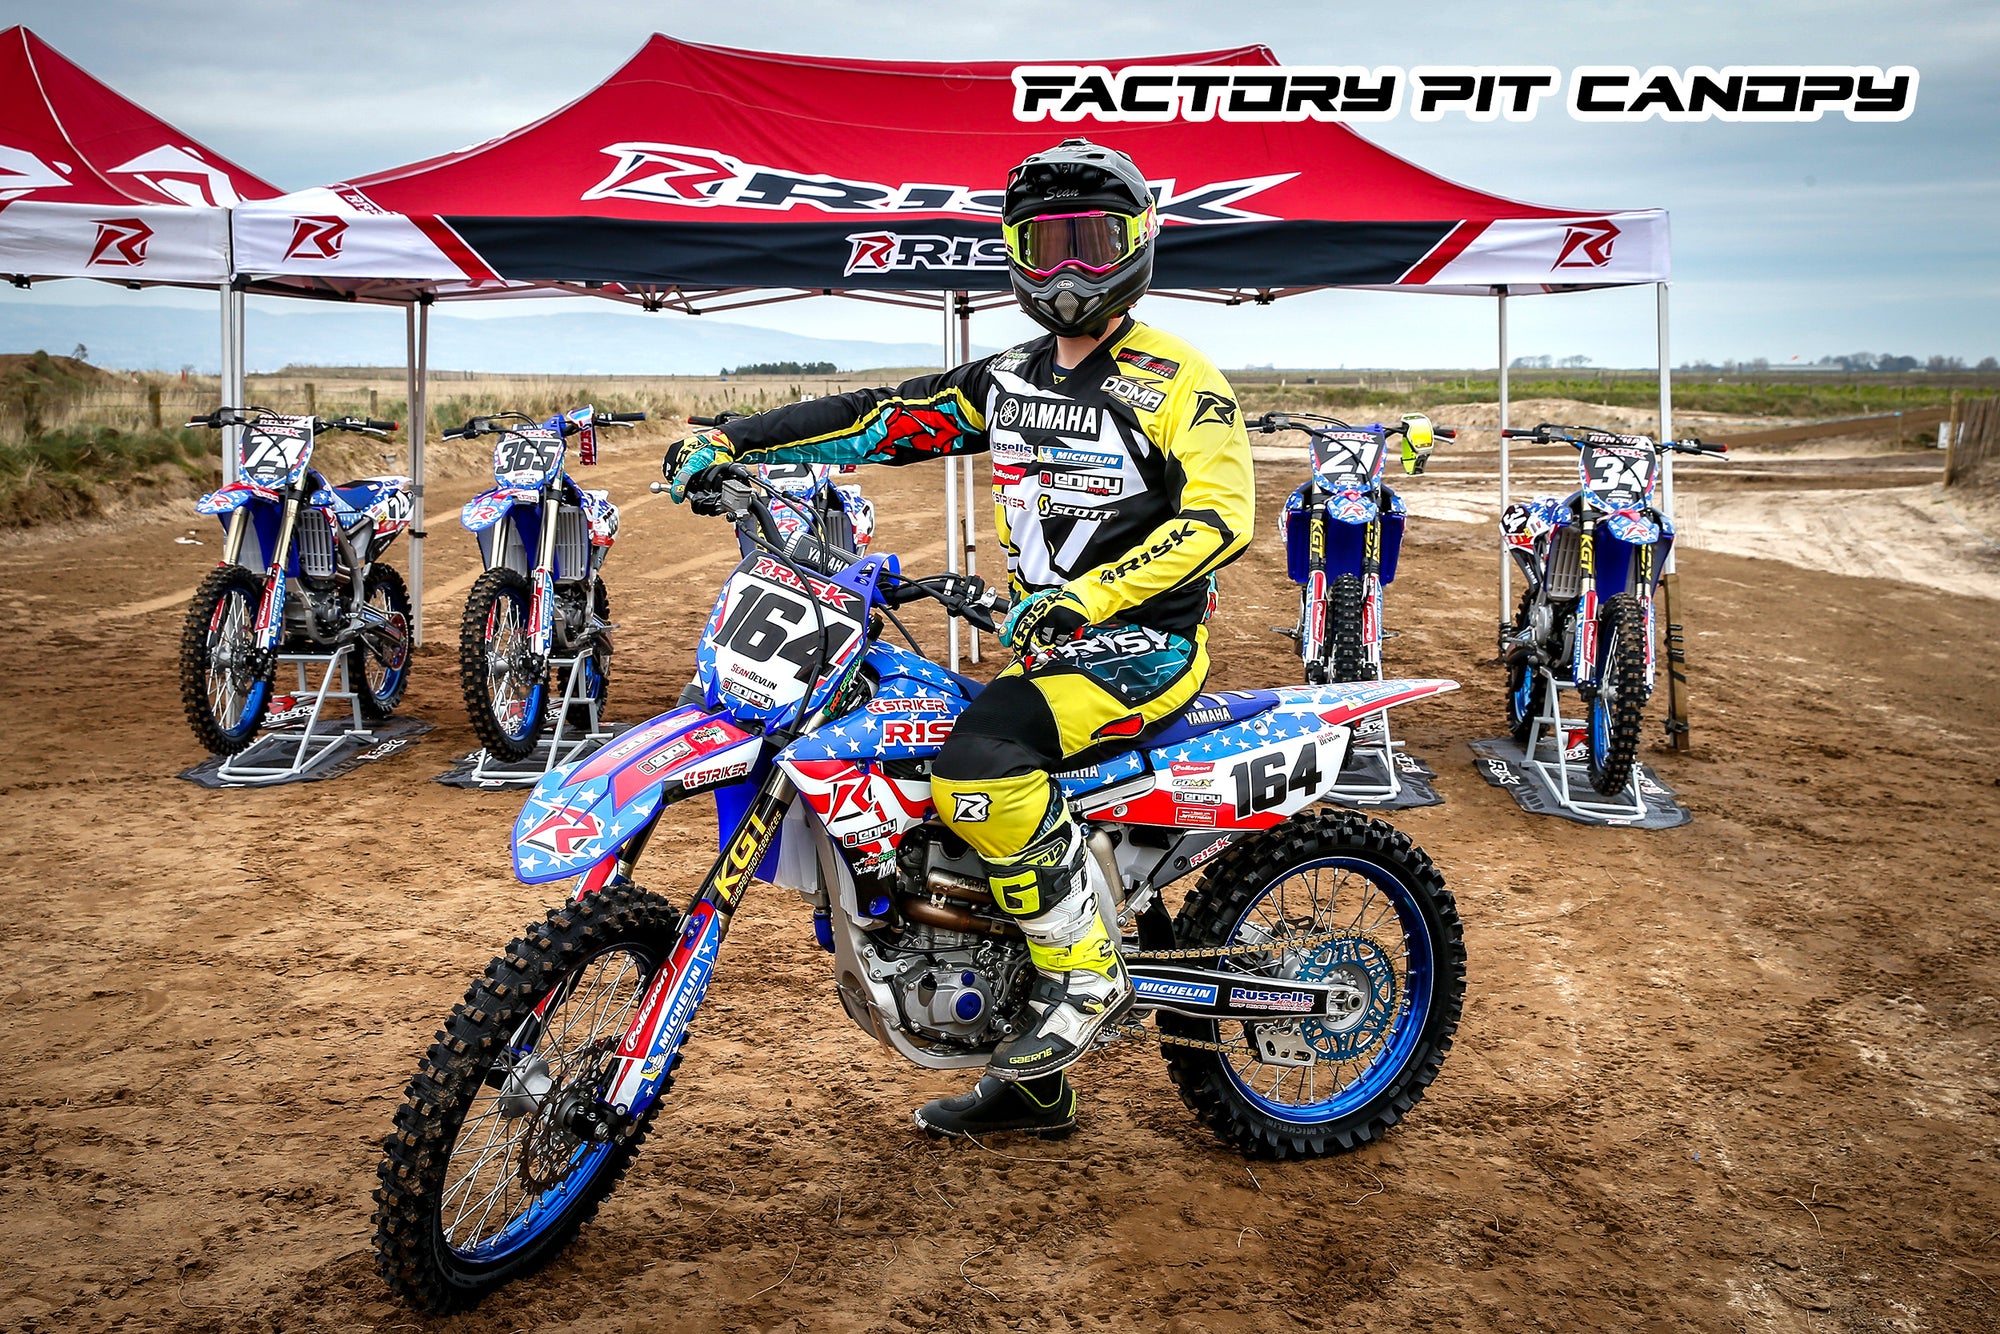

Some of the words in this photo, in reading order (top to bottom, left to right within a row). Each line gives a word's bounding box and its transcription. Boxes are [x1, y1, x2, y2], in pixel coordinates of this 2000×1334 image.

[1100, 376, 1165, 409] DOMA
[1018, 401, 1098, 435] YAMAHA
[243, 436, 307, 469] 74
[495, 440, 561, 475] 365
[1055, 451, 1119, 465] MICHELIN
[1319, 440, 1379, 475] 21
[1054, 472, 1121, 494] enjoy
[1588, 457, 1650, 492] 34
[1050, 504, 1118, 520] SCOTT
[1114, 521, 1197, 580] RISK
[713, 584, 856, 686] 164
[730, 663, 750, 678] SEAN
[748, 671, 778, 690] DEVLIN
[883, 699, 948, 712] STRIKER
[1184, 706, 1232, 726] YAMAHA
[696, 762, 748, 787] STRIKER
[1229, 741, 1323, 821] 164
[713, 812, 767, 902] KGT
[1189, 832, 1233, 868] RISK
[1137, 981, 1212, 999] MICHELIN
[1231, 987, 1315, 1003] Russells
[625, 966, 670, 1052] Polisport
[657, 964, 702, 1050] MICHELIN
